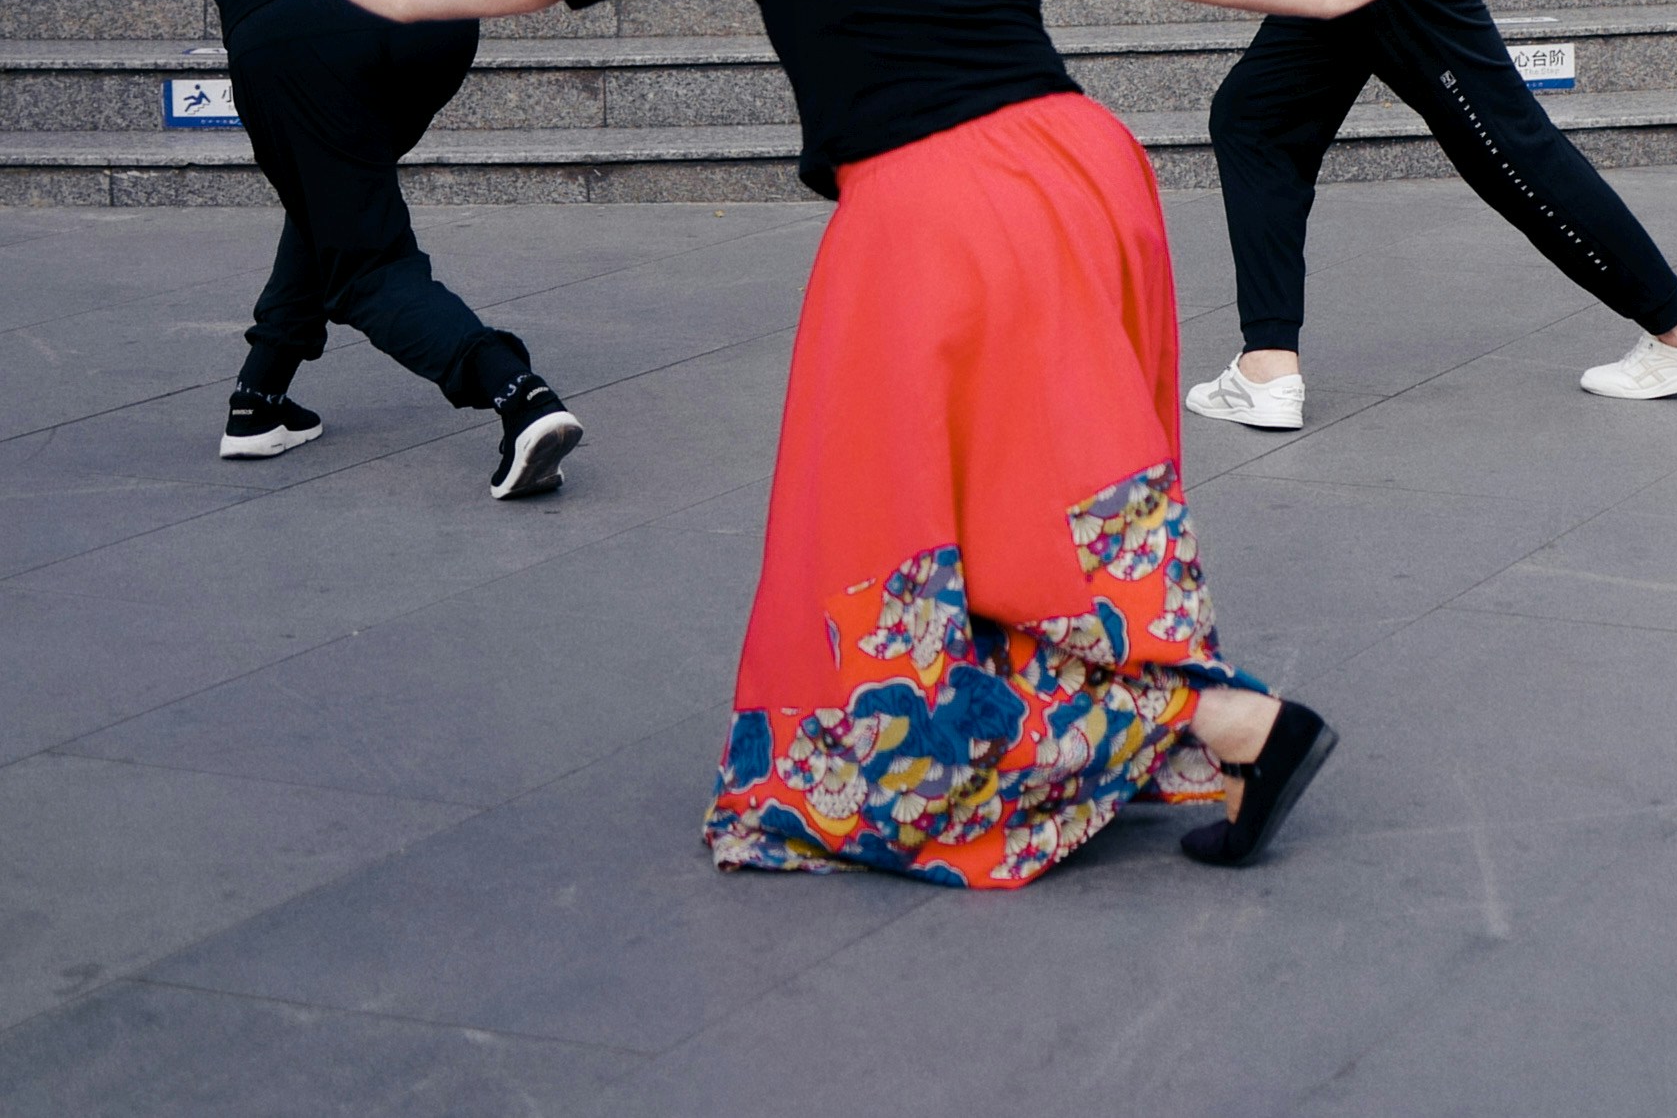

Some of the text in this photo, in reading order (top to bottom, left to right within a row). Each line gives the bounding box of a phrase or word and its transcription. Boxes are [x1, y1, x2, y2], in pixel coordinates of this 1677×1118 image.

[1514, 48, 1566, 68] 心台阶
[1452, 88, 1499, 155] MOVEMENT
